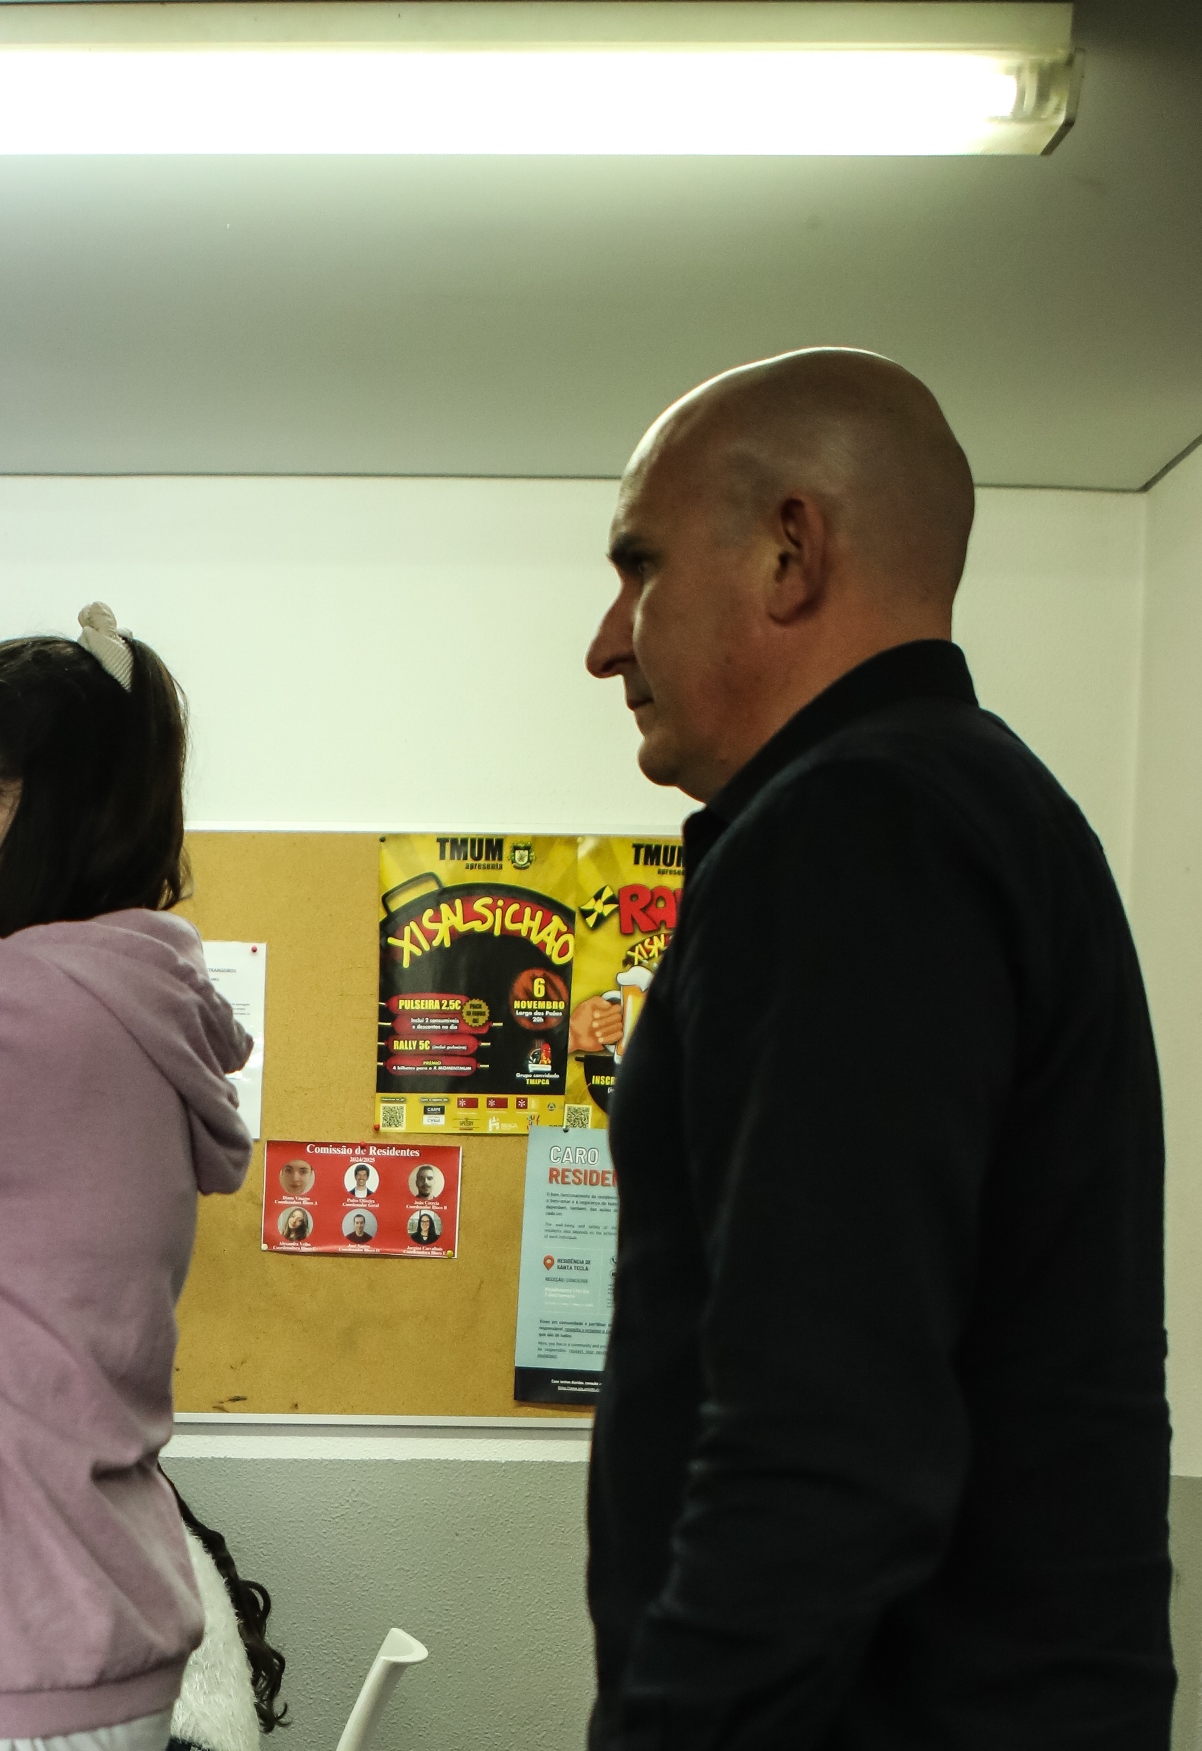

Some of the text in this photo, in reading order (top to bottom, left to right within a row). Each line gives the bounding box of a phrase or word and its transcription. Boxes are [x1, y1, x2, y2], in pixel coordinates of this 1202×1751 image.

[437, 838, 503, 861] TMUM
[533, 978, 545, 997] 6
[399, 999, 440, 1010] PULSEIRA
[514, 1001, 565, 1009] NOVEMBRO
[393, 1040, 417, 1050] RALLY
[306, 1144, 420, 1157] Comissão de Residentes
[549, 1145, 599, 1165] CARO
